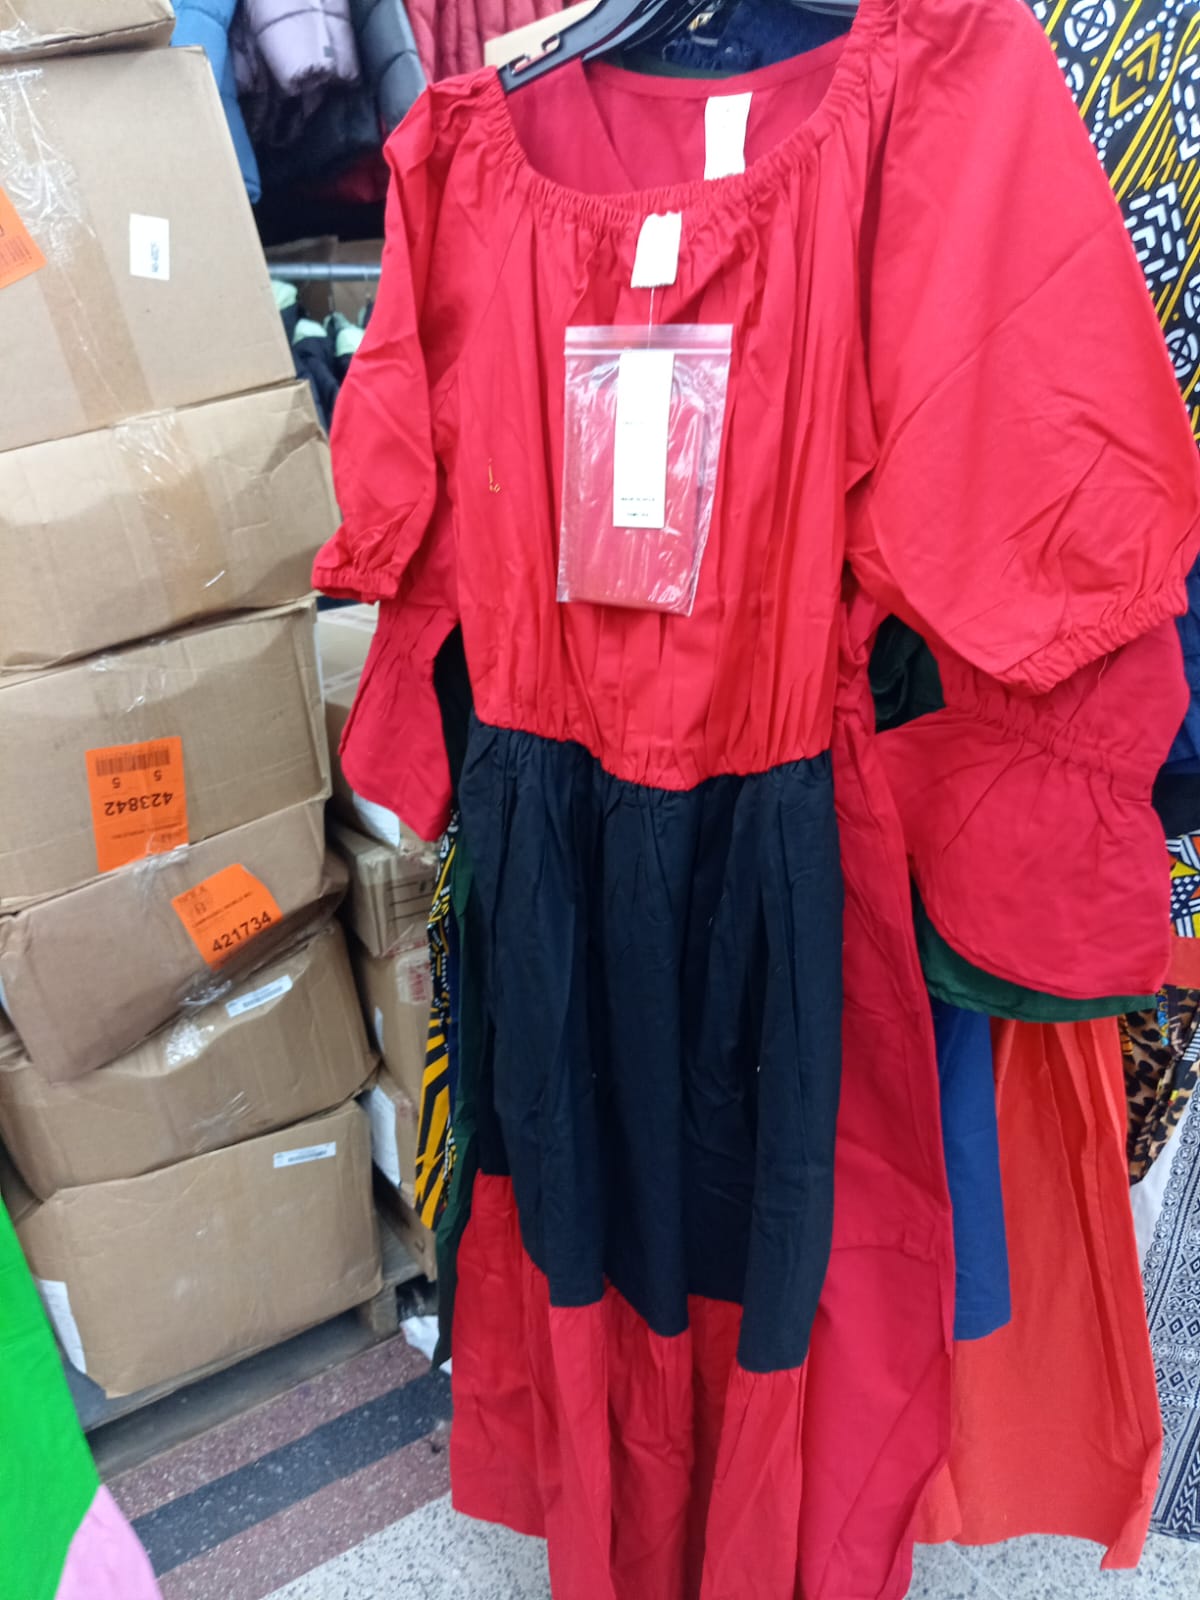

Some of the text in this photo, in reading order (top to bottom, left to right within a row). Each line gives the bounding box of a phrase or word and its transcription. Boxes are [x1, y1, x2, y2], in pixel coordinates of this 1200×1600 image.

[112, 769, 162, 789] 5 5
[104, 792, 173, 816] 423842
[212, 911, 272, 952] 421734
